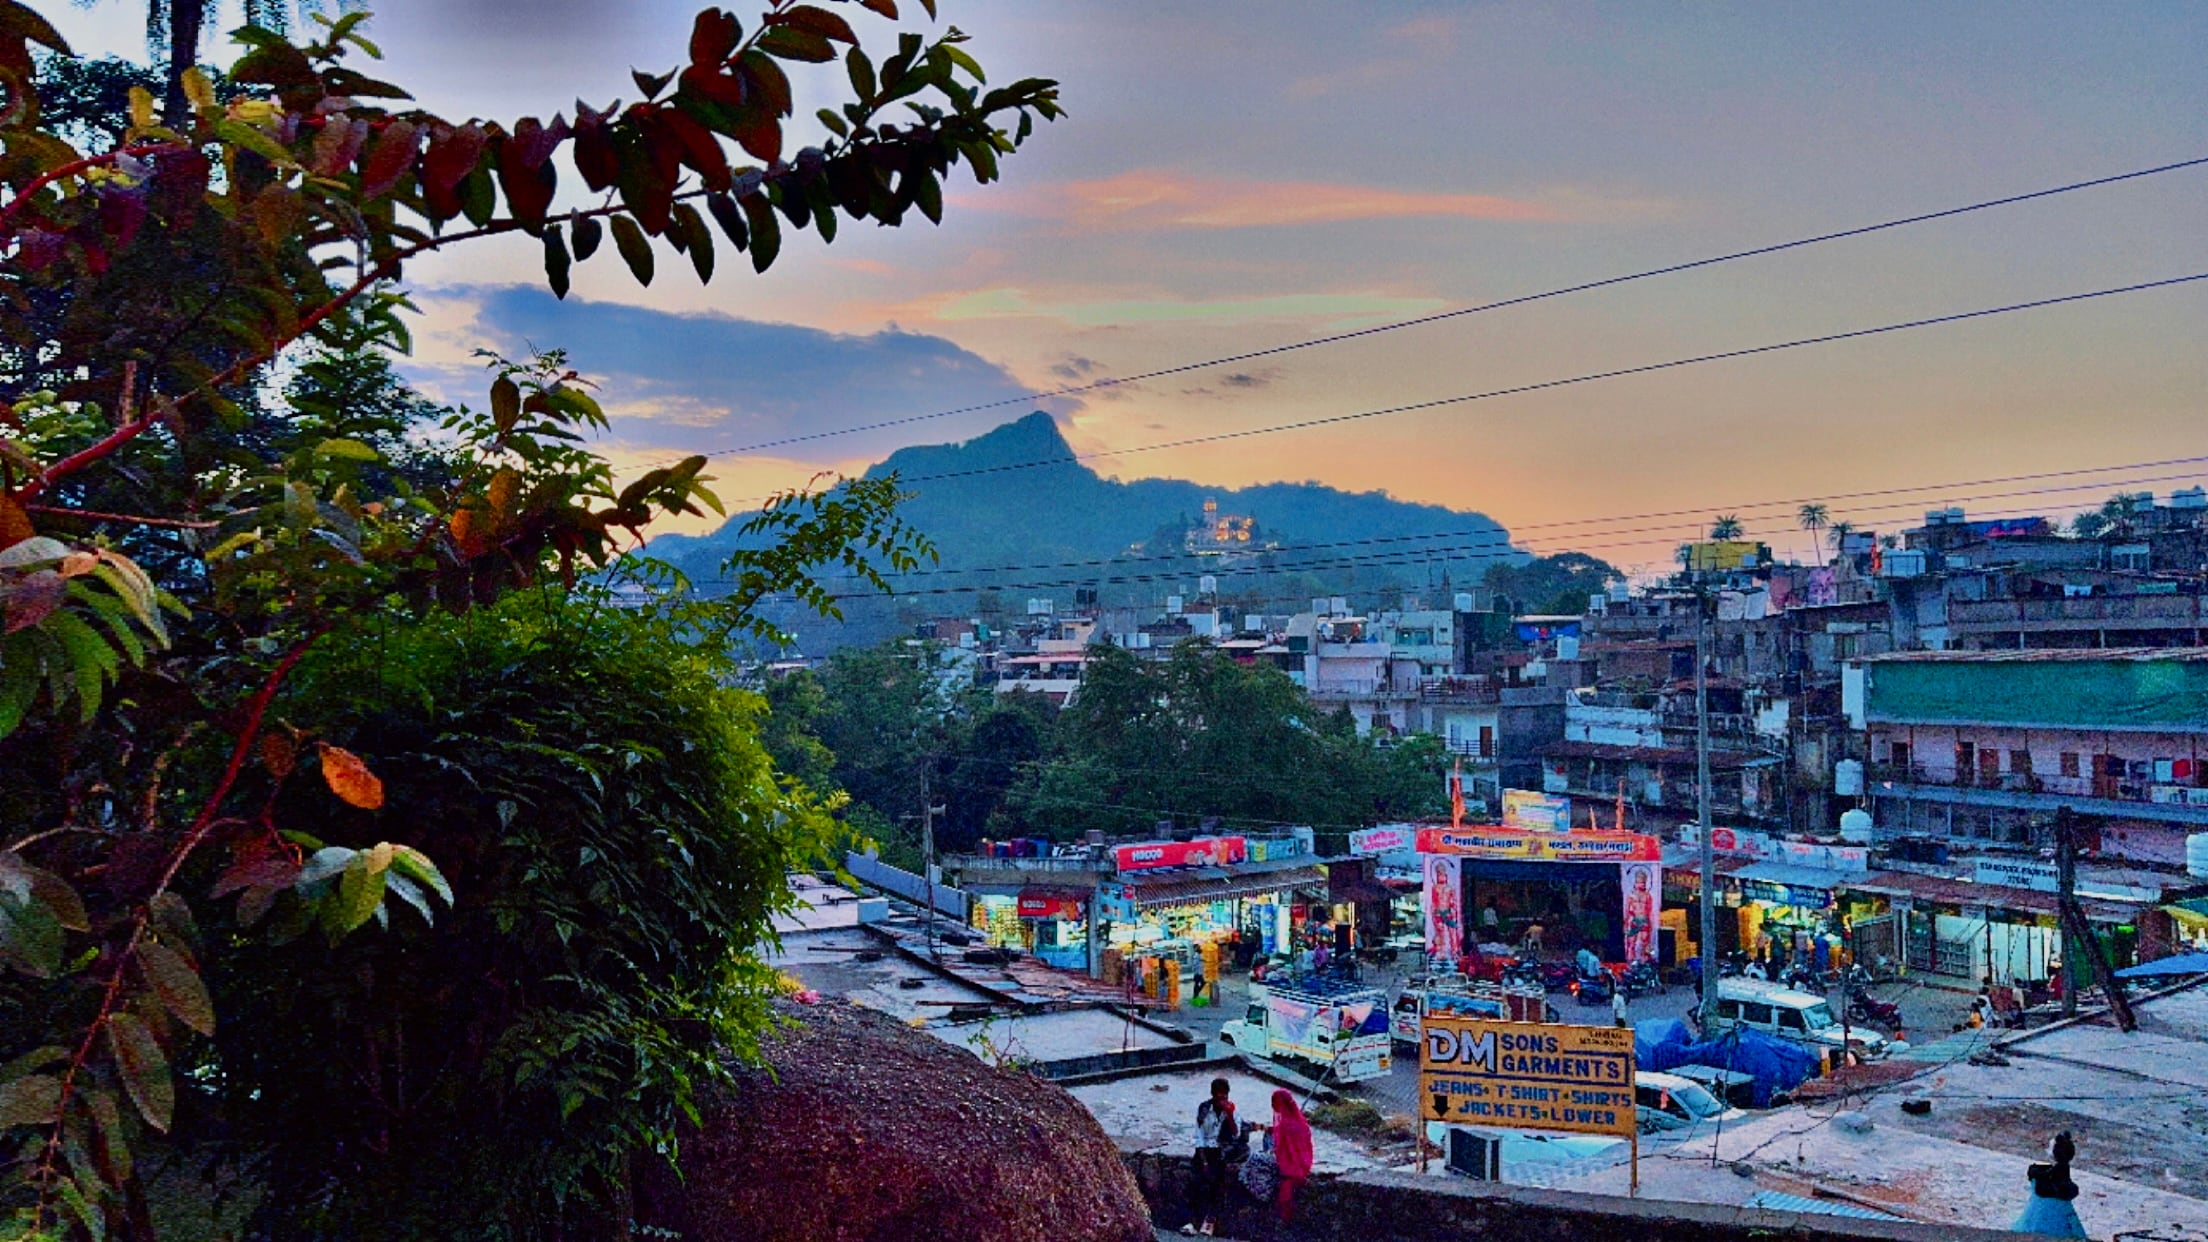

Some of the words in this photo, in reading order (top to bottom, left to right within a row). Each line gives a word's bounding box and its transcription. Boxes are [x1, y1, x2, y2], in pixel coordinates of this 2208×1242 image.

[1426, 1027, 1498, 1073] DM
[1502, 1054, 1620, 1079] GARMENTS
[1428, 1080, 1483, 1097] JEANS
[1572, 1090, 1632, 1107] SHIRTS
[1458, 1101, 1538, 1120] JACKETS
[1550, 1109, 1616, 1125] LOWER
